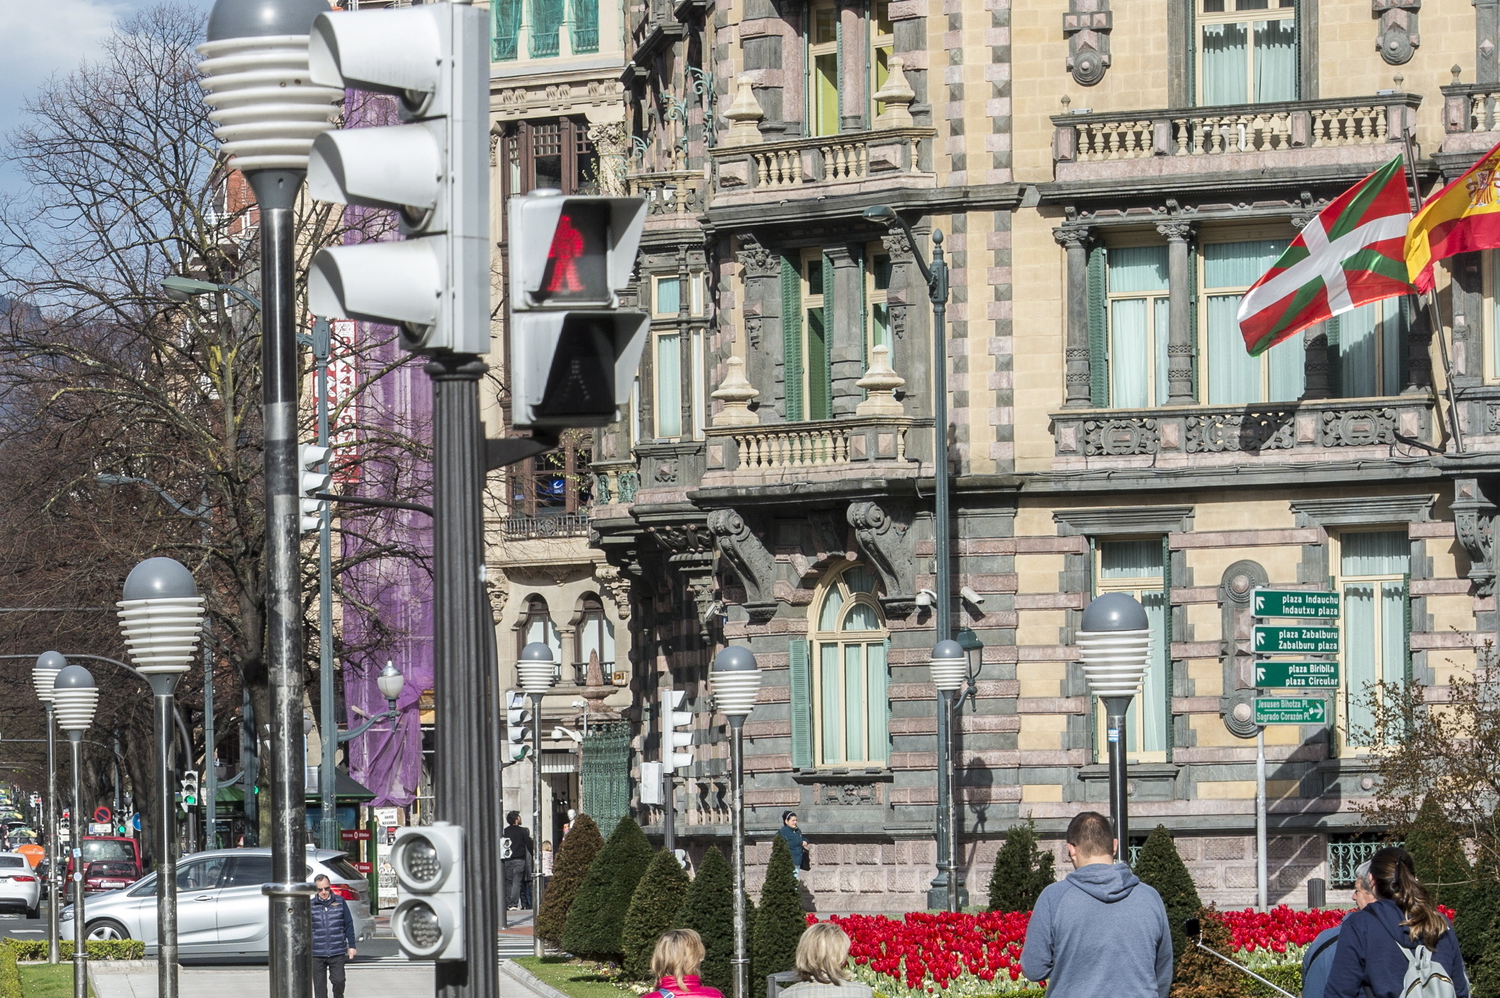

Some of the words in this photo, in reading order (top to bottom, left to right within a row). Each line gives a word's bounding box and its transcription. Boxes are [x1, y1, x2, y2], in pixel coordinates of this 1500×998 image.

[1282, 594, 1302, 604] plaza
[1305, 595, 1339, 604] Indauchu
[1282, 606, 1315, 614] Indautxu
[1318, 606, 1338, 616] plaza
[1278, 629, 1299, 639] plaza
[1301, 629, 1338, 638] Zabalburu
[1278, 641, 1315, 649] Zabalburu
[1318, 641, 1338, 651] plaza
[1288, 664, 1307, 674] plaza
[1309, 664, 1335, 673] Biribila
[1285, 677, 1305, 687] plaza
[1308, 676, 1338, 685] Circular
[1257, 700, 1281, 708] Jesusen
[1281, 700, 1301, 708] Bihotza
[1256, 712, 1280, 723] Sagrado
[1280, 711, 1303, 720] Corazón
